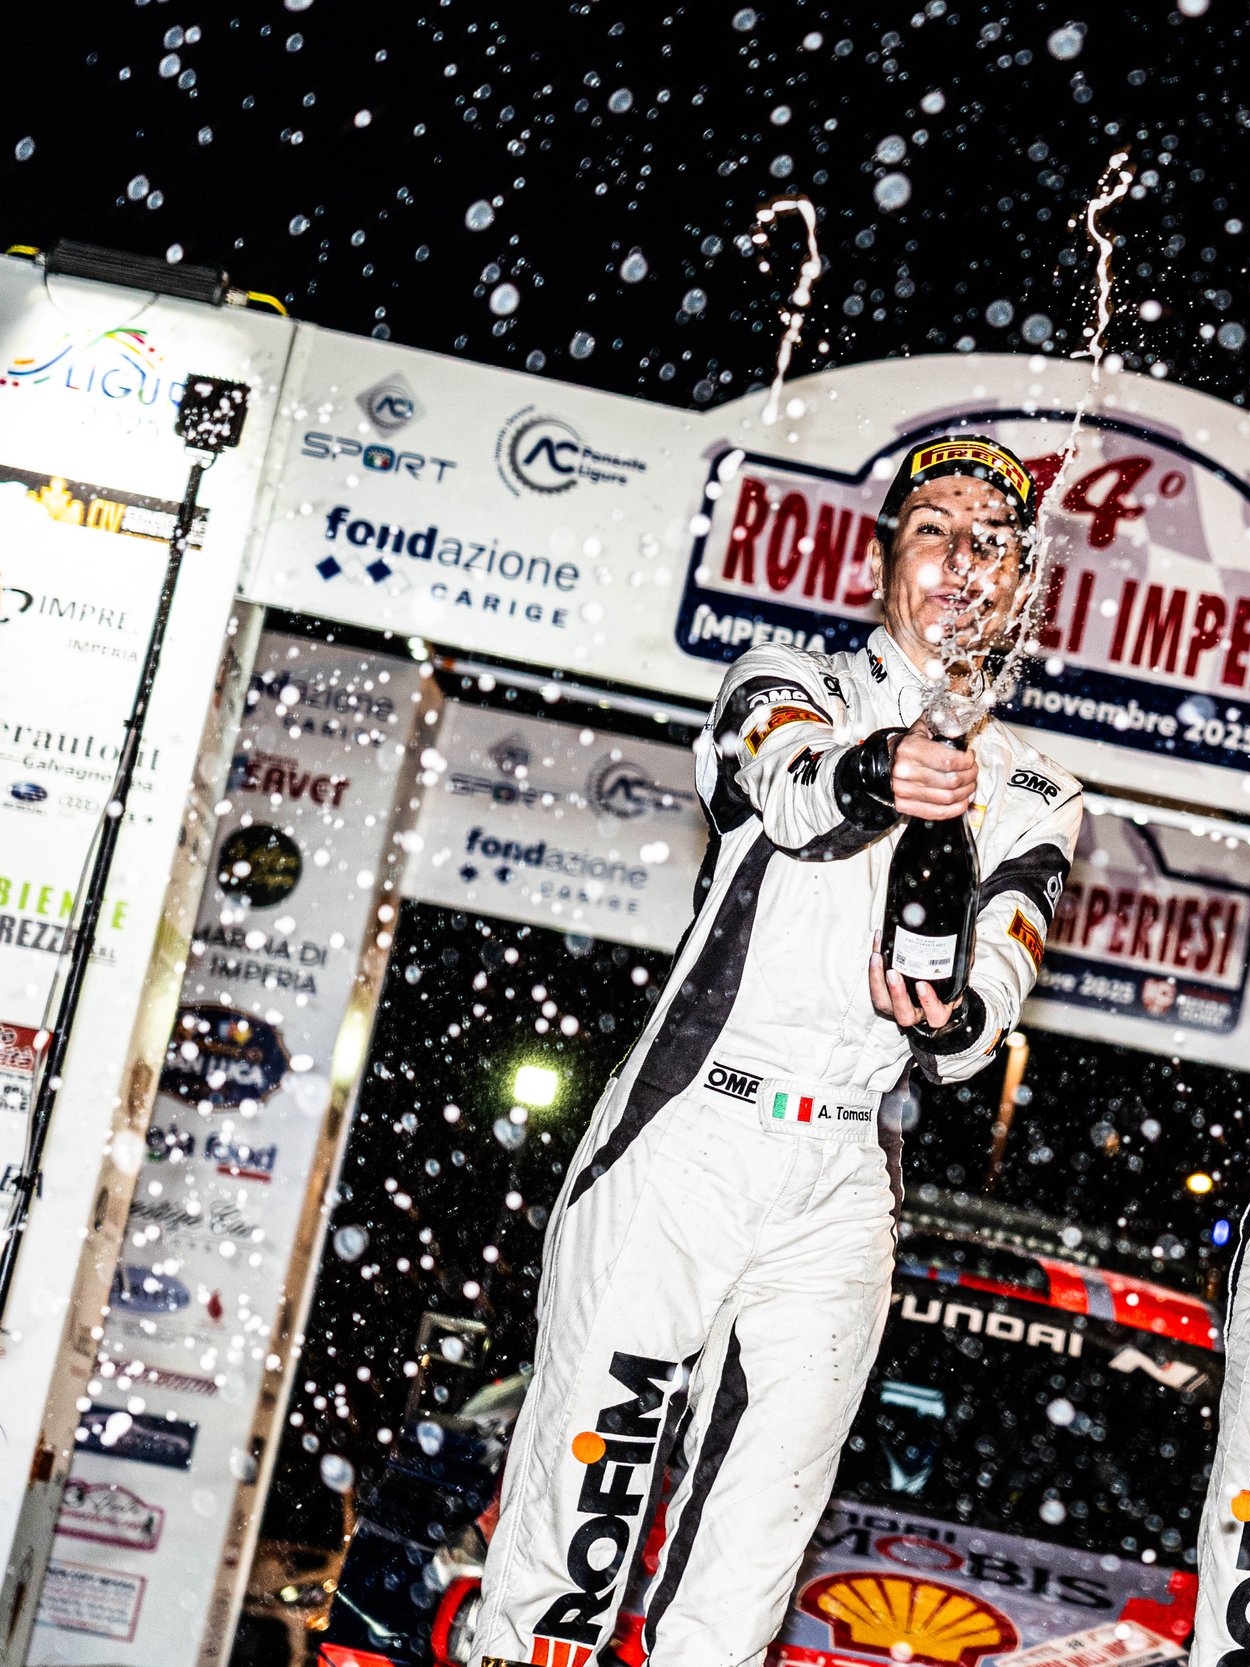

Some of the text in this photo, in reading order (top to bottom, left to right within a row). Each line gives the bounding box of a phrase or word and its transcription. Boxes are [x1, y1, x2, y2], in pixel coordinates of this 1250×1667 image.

[301, 430, 458, 484] SPORT
[325, 505, 580, 592] fondazione
[430, 582, 568, 628] CARIGE
[1022, 686, 1178, 737] novembre
[1011, 773, 1057, 798] OMP
[466, 826, 648, 889] fondazione
[708, 1068, 759, 1098] OMP
[818, 1105, 832, 1119] A.
[891, 1294, 1084, 1358] UNDAI
